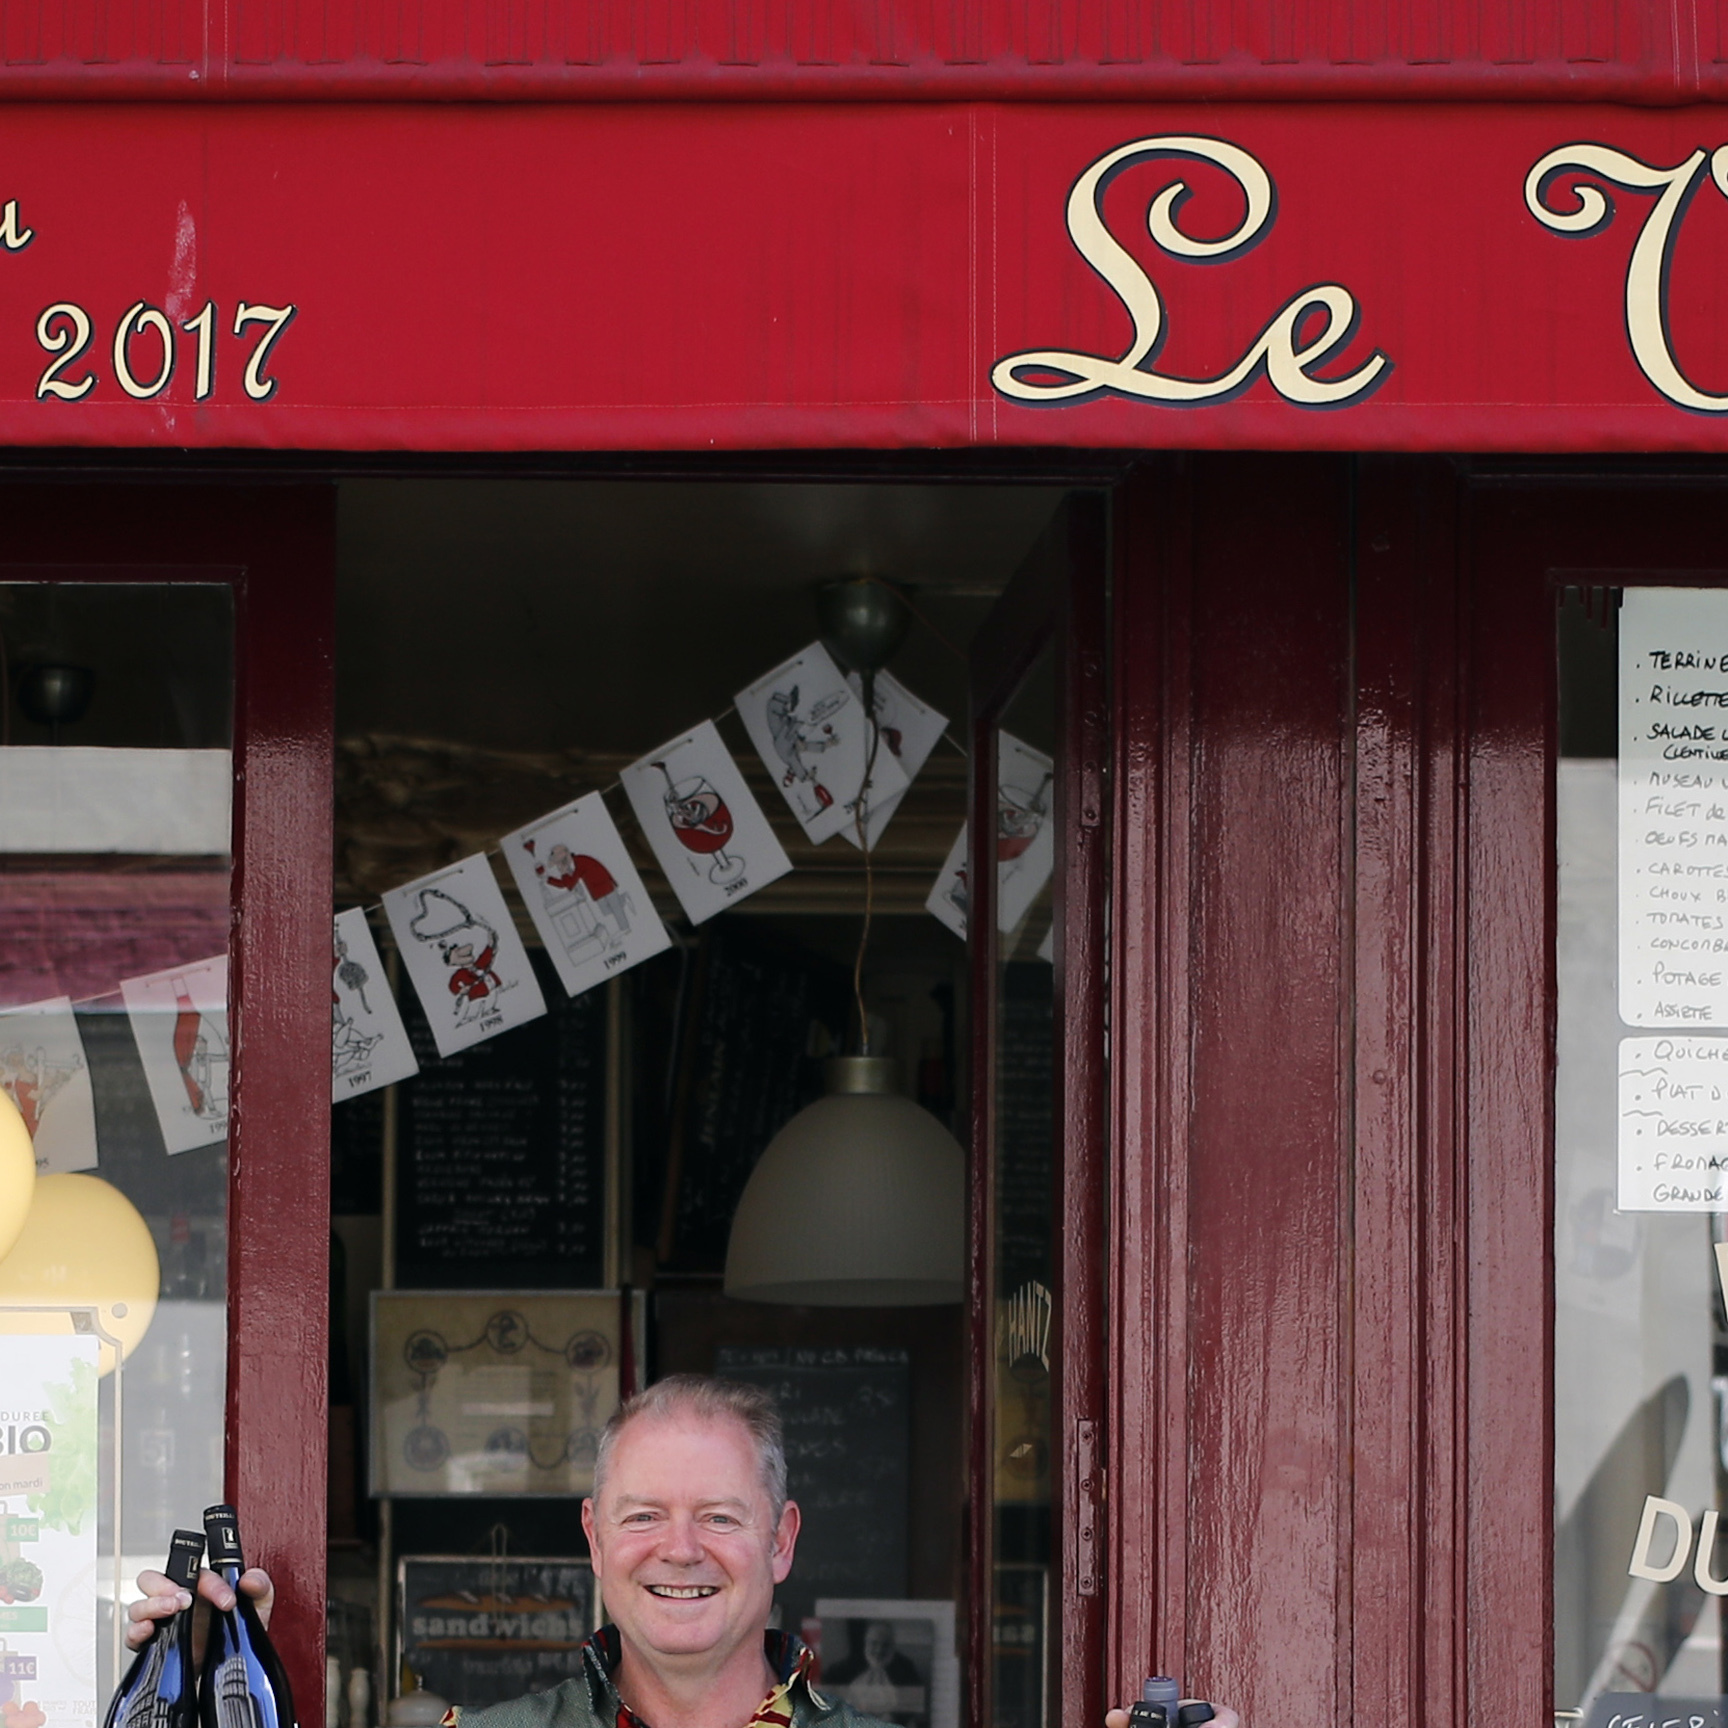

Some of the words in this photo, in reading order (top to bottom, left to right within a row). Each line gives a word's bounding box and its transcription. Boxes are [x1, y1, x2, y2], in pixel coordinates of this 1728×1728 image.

[991, 134, 1387, 404] Le
[36, 300, 296, 400] 2017
[1646, 722, 1716, 743] SALADE
[1645, 798, 1701, 821] FILET
[1649, 887, 1702, 904] CHOUX
[1650, 1076, 1704, 1101] PLAT
[1653, 1183, 1724, 1203] GRANDE
